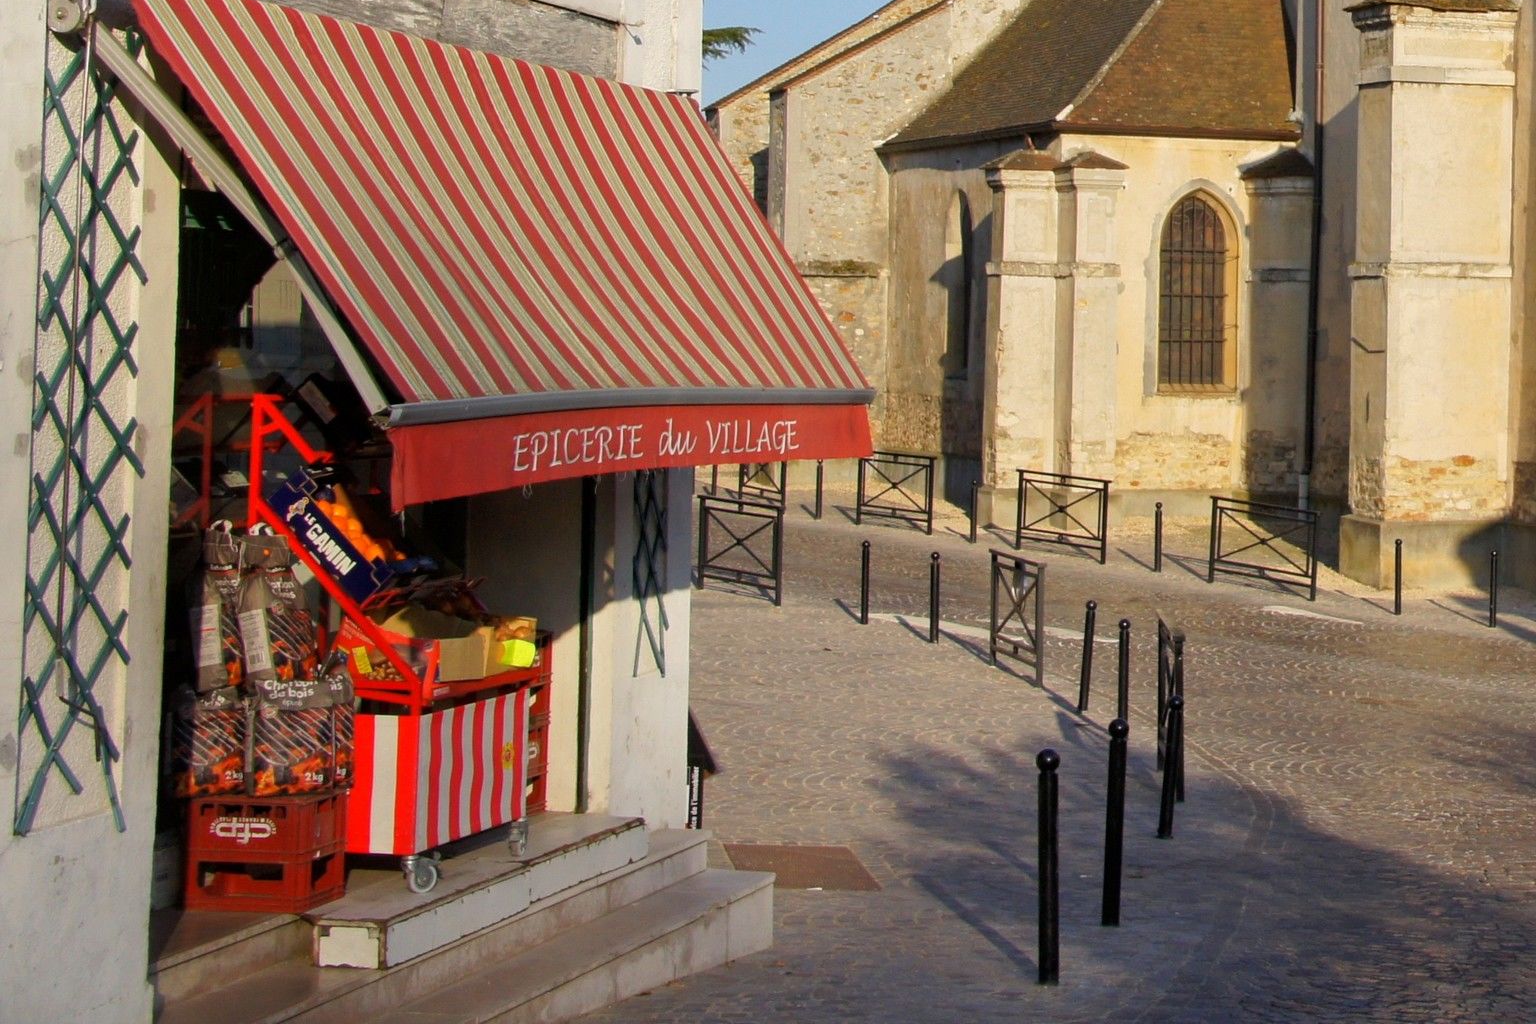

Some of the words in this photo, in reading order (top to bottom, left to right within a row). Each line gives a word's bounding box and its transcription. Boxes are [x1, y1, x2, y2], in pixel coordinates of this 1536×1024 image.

[512, 424, 644, 472] EPICERIE
[659, 418, 697, 457] du
[706, 419, 800, 455] VILLAGE
[305, 523, 357, 576] GAMIN
